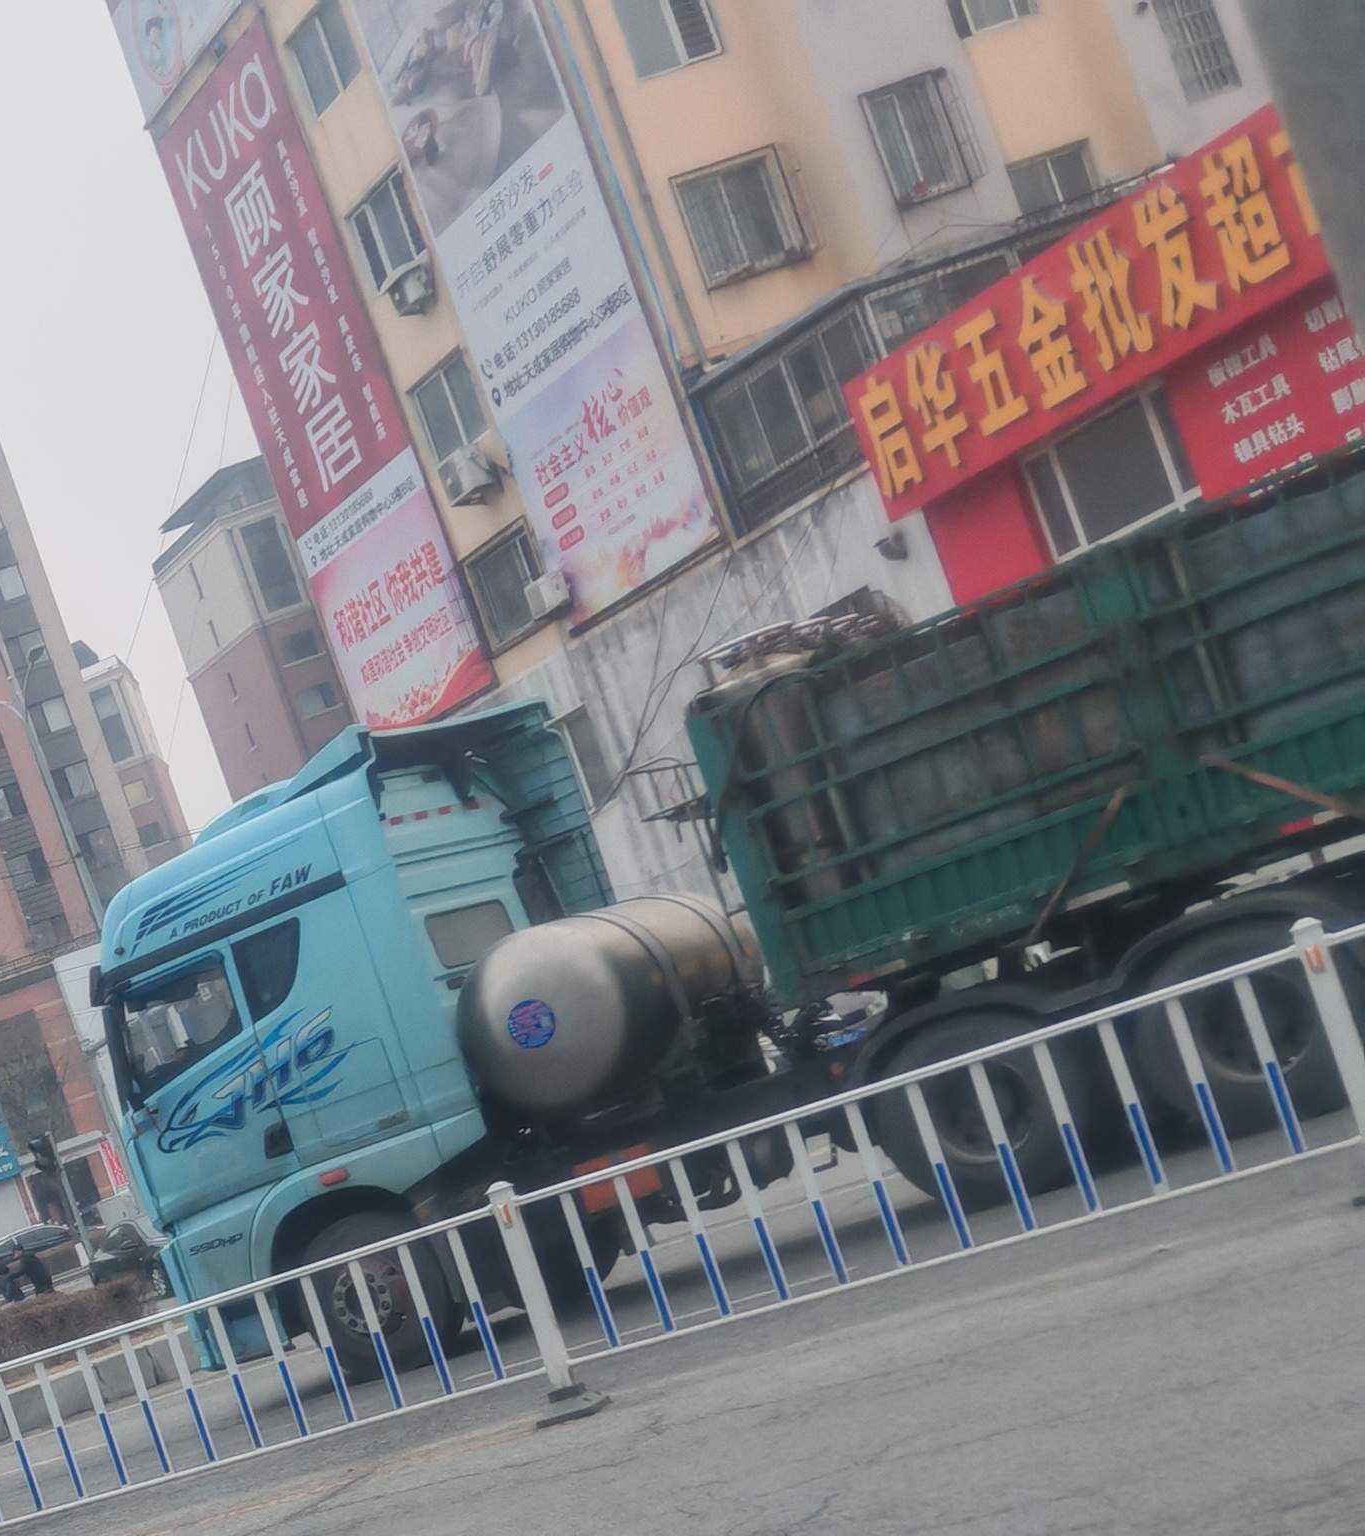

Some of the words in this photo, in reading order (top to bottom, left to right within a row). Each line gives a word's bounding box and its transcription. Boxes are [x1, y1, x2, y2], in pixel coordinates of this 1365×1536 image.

[476, 165, 538, 235] 云舒沙发
[224, 160, 362, 494] 顾家家居
[534, 432, 589, 487] 社会主义
[581, 368, 624, 444] 核心
[1221, 373, 1292, 424] 木瓦工具
[333, 580, 391, 653] 和谐社区
[384, 540, 446, 615] 你我共建
[170, 928, 178, 939] A
[183, 900, 243, 934] PRODUCT
[246, 889, 265, 906] OF
[269, 863, 312, 897] FAW
